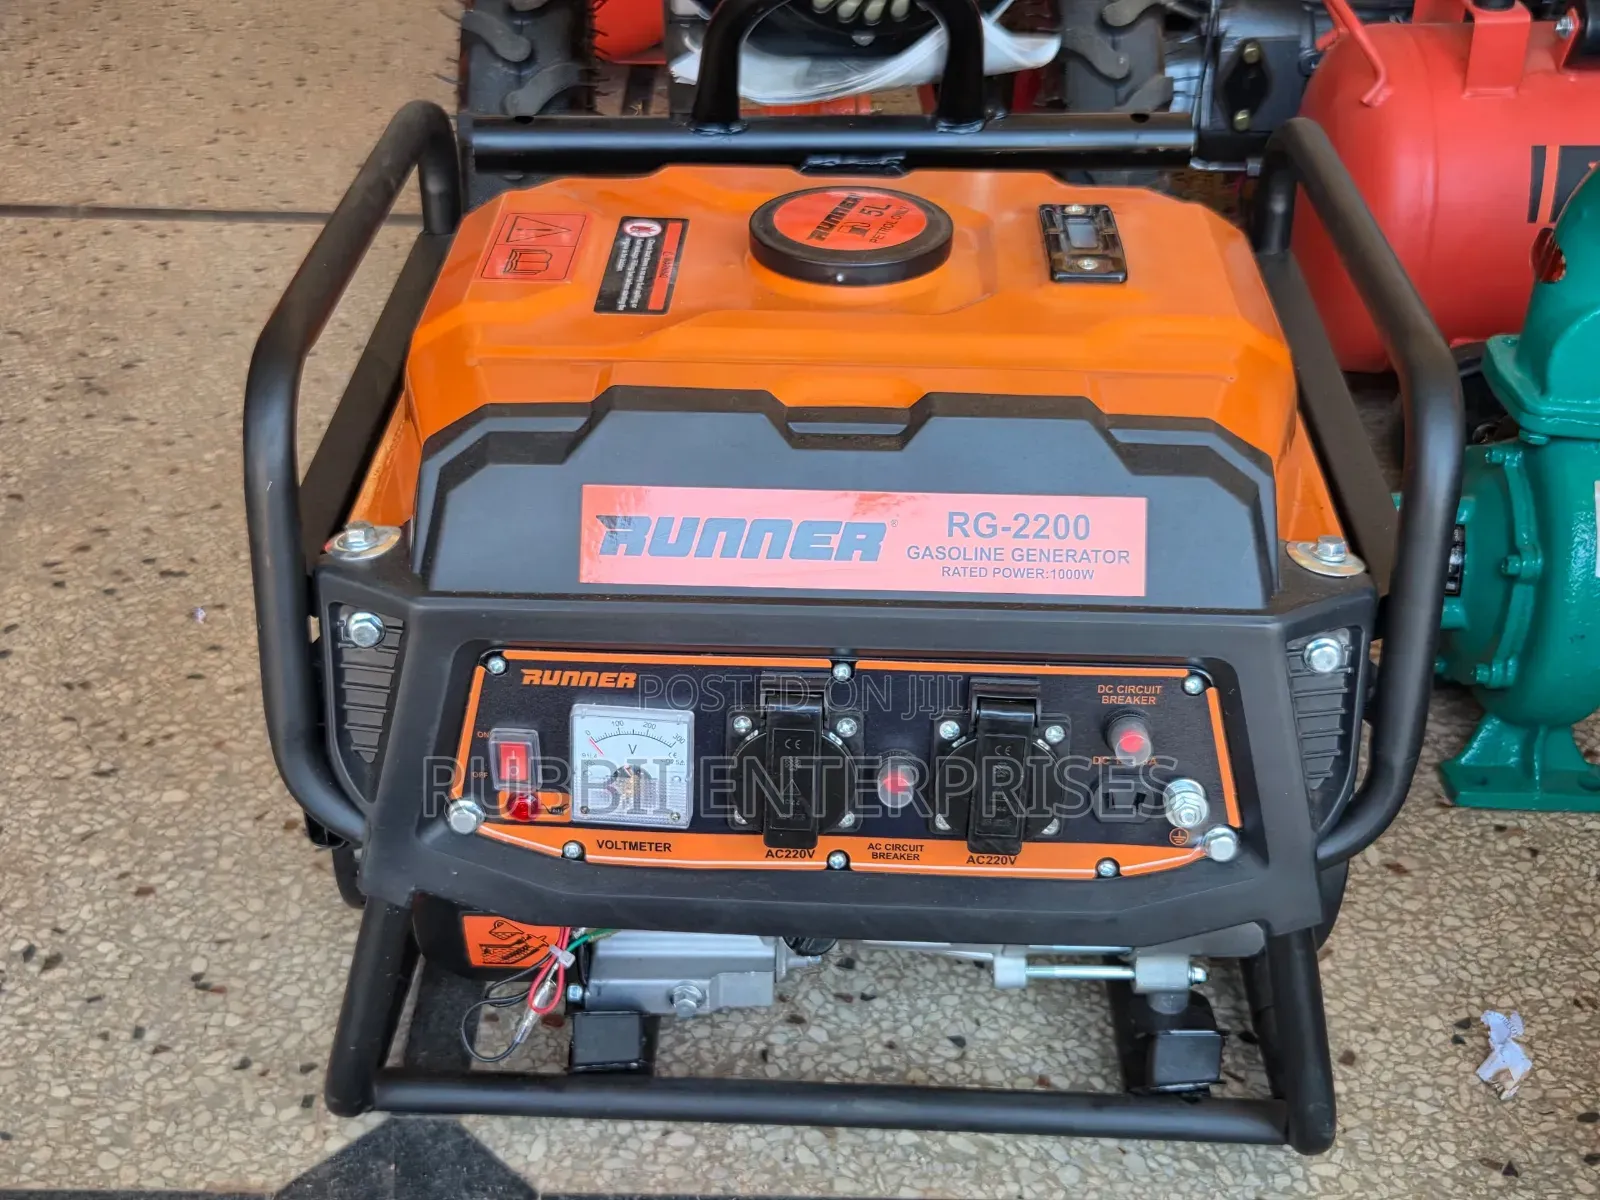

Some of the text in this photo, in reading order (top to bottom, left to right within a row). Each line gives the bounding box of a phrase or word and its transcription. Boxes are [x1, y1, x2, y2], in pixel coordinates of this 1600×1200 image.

[859, 204, 892, 217] 5L
[869, 220, 899, 243] PETROL
[947, 511, 1091, 541] RG-2200
[595, 514, 887, 562] RUNNER
[906, 545, 1131, 564] GASOLINE GENERATOR
[941, 566, 1095, 580] RATED POWER:1000W
[520, 669, 638, 689] RUNNER
[1097, 685, 1162, 694] DC CIRCUIT
[1101, 696, 1156, 705] BREAKER
[643, 721, 657, 730] 200
[672, 733, 686, 745] 300
[628, 744, 637, 755] V
[596, 839, 672, 852] VOLTMETER
[867, 842, 924, 852] AC CIRCUIT
[765, 849, 816, 859] AC220V
[871, 852, 920, 861] BREAKER
[966, 855, 1018, 865] AC220V
